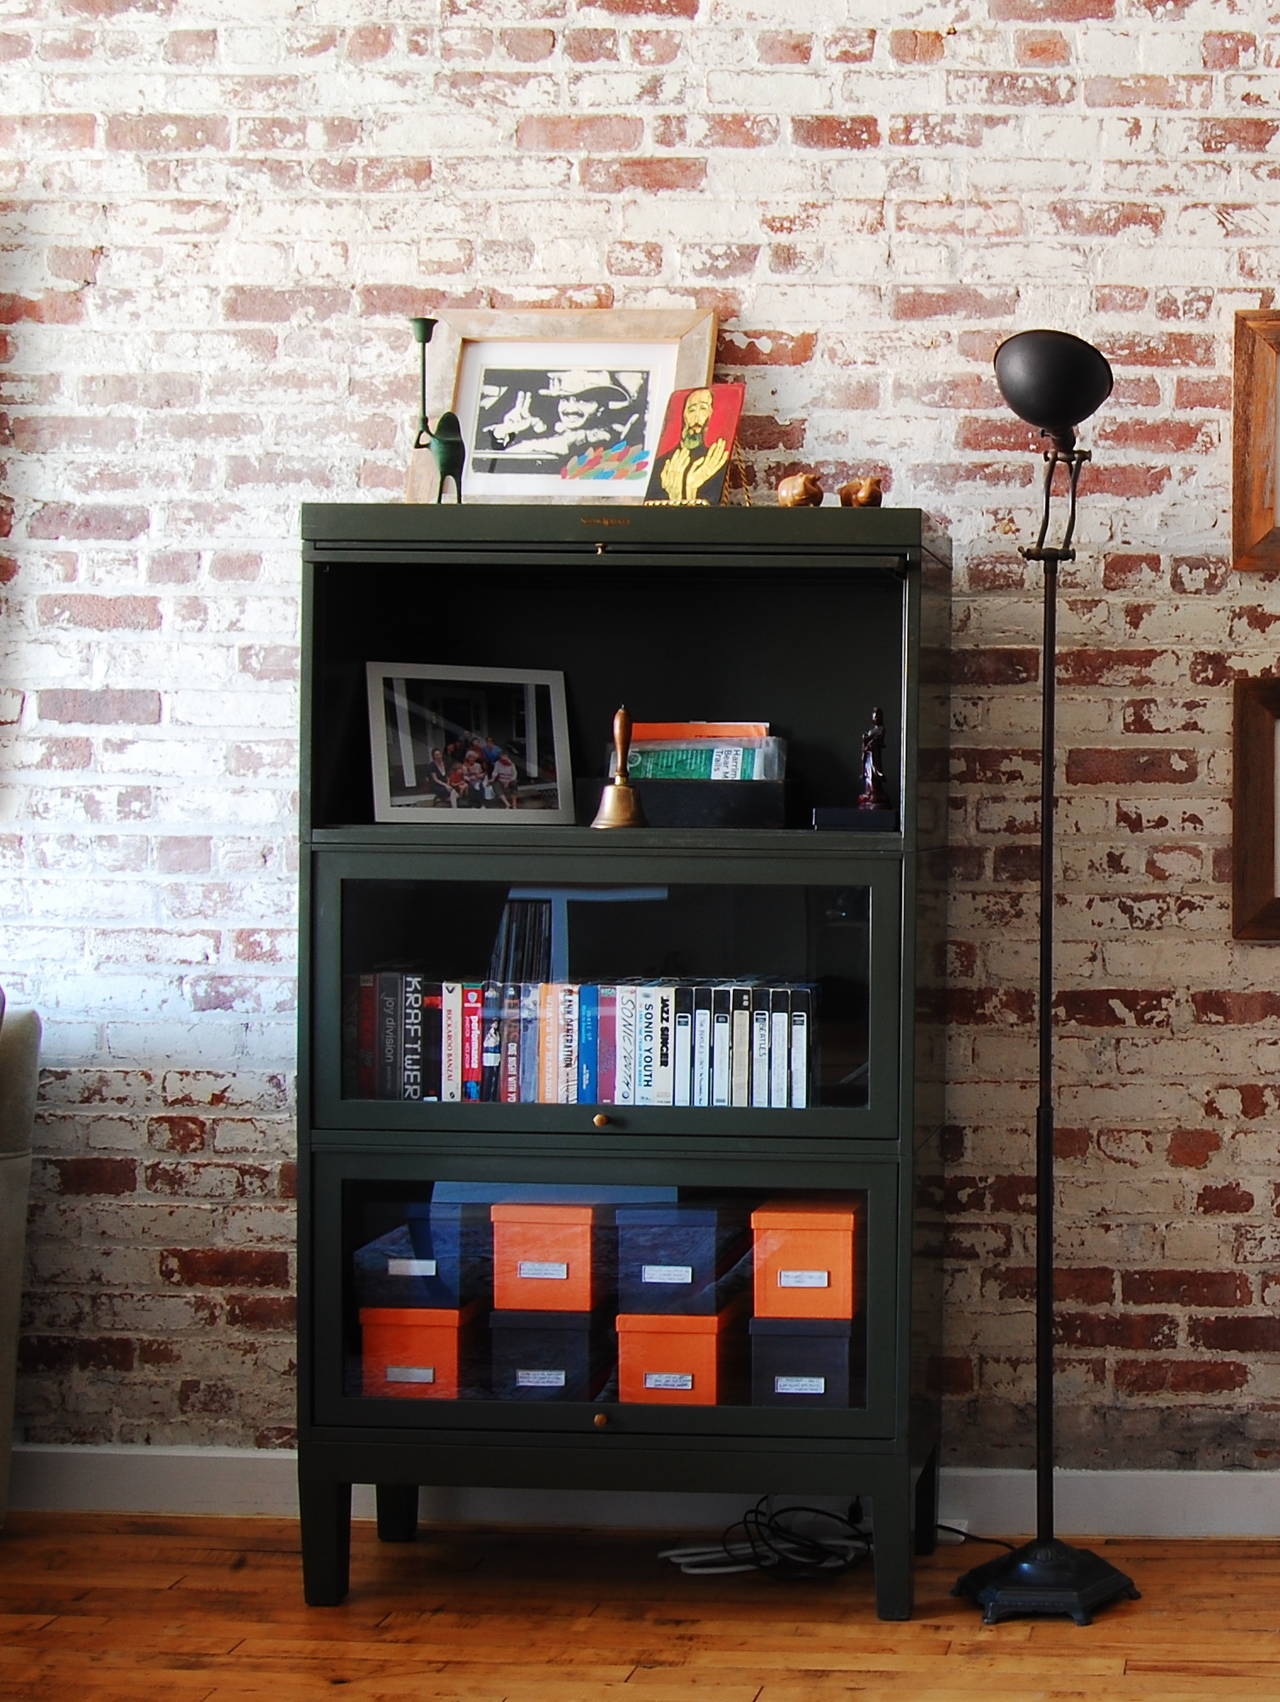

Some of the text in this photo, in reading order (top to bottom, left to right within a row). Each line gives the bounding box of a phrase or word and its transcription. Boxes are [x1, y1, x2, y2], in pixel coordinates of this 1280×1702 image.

[714, 749, 723, 772] Trails
[724, 749, 732, 768] Bear
[383, 996, 396, 1014] joy
[385, 1017, 396, 1062] division
[563, 1018, 573, 1068] GENERATION
[621, 995, 635, 1091] SONIC YOUTH
[660, 996, 669, 1068] JAZZ SINGER
[508, 1042, 517, 1055] ONE
[643, 1003, 654, 1088] SONIC YOUTH
[508, 1057, 517, 1074] NIGHT
[508, 1077, 517, 1092] WITH
